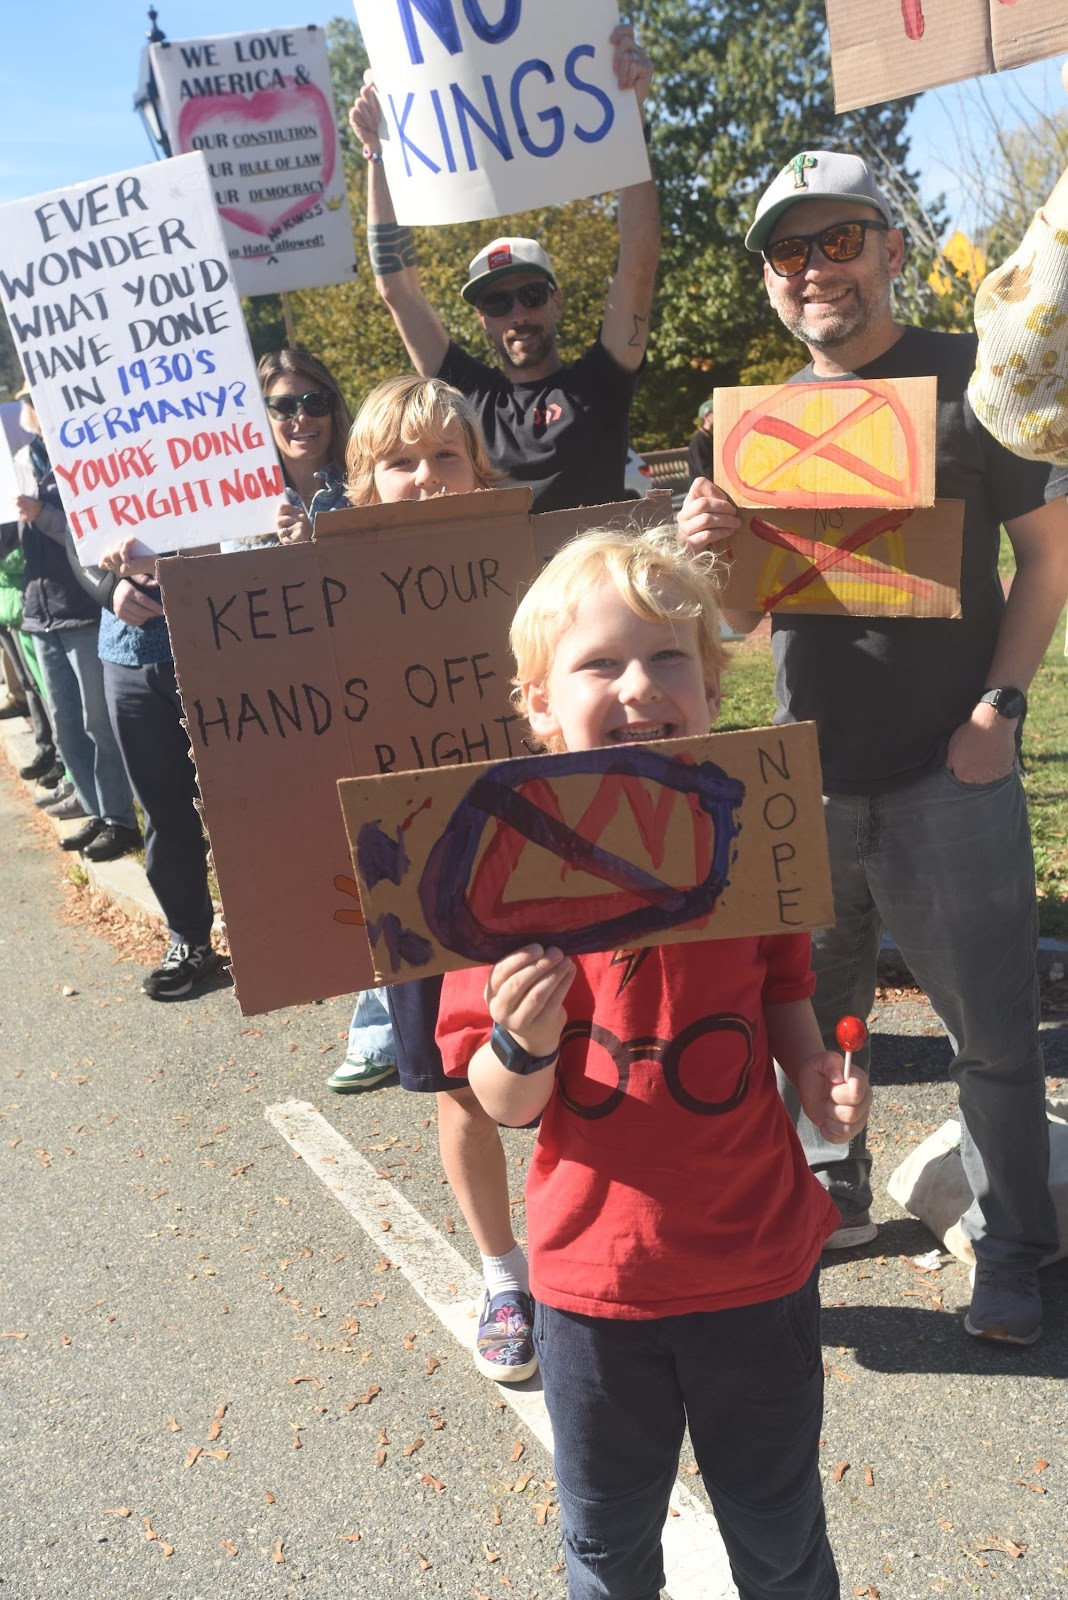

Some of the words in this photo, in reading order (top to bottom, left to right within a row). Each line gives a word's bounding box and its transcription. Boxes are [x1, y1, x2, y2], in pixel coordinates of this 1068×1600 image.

[180, 43, 220, 69] WE
[234, 34, 297, 63] LOVE
[180, 67, 286, 101] AMERICA
[295, 64, 311, 87] &
[191, 132, 229, 151] OUR
[387, 44, 615, 178] KINGS
[207, 161, 234, 178] UR
[238, 160, 273, 177] RULE
[275, 157, 293, 170] OF
[295, 152, 323, 167] LAW
[214, 188, 240, 205] UR
[248, 181, 325, 203] DEMOCRACY
[35, 176, 148, 243] EVER
[0, 217, 197, 299] WONDER
[242, 243, 272, 257] Hate
[275, 234, 325, 252] allowed!
[9, 287, 110, 344] WHAT
[122, 258, 229, 309] YOU'D
[22, 334, 115, 387] HAVE
[128, 300, 231, 354] DONE
[61, 377, 106, 412] IN
[117, 348, 217, 397] 1930'S
[59, 382, 248, 449] GERMANY?
[168, 422, 266, 465] DOING
[69, 507, 99, 539] IT
[107, 478, 213, 526] RIGHT
[219, 464, 285, 508] NOW
[814, 508, 844, 534] NO
[207, 576, 348, 650] KEEP
[380, 558, 512, 615] YOUR
[193, 678, 368, 747] HANDS
[404, 652, 496, 708] OFF
[757, 739, 804, 926] NOPE
